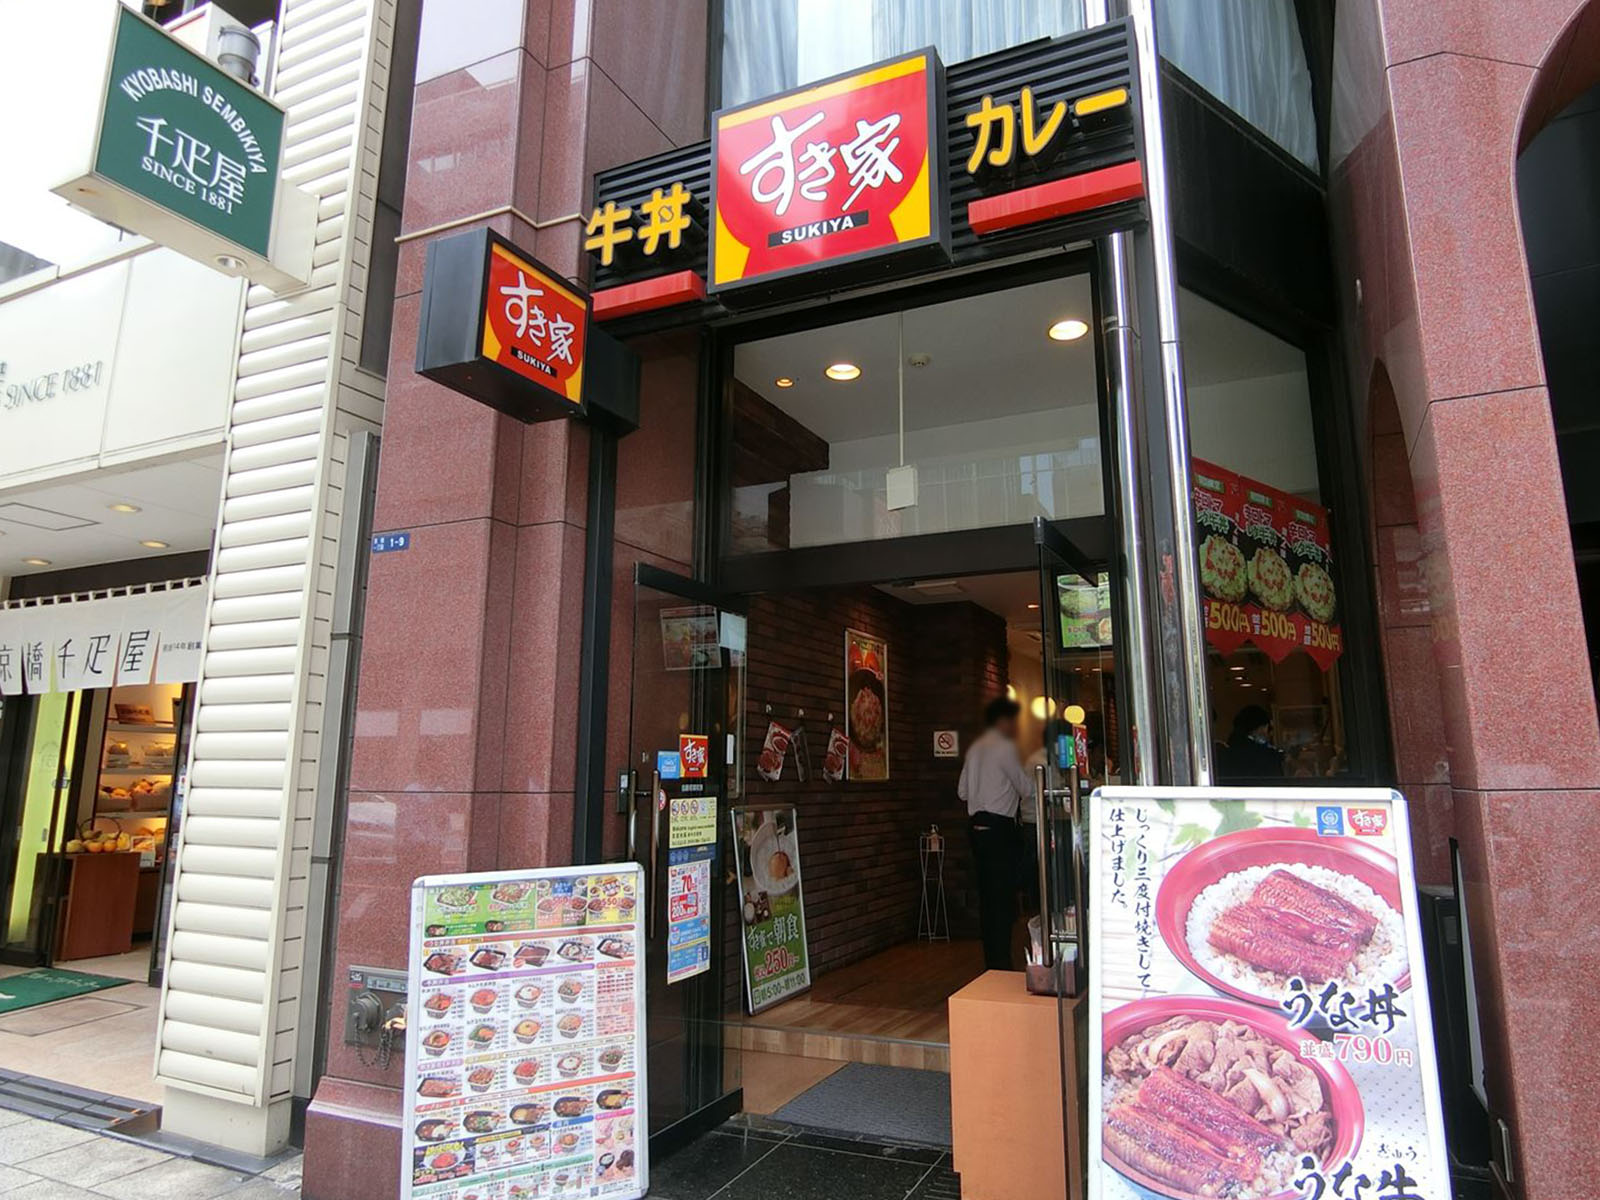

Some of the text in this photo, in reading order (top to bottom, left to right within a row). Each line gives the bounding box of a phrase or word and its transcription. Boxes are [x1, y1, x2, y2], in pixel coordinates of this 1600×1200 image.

[120, 67, 267, 175] KYOBASHI SEMBIKIYA
[136, 113, 247, 205] 千疋屋
[740, 111, 904, 217] すき家
[965, 86, 1128, 174] カレー
[141, 156, 234, 215] SINCE 1881
[585, 181, 692, 267] 牛丼
[781, 214, 855, 245] SUKIYA
[499, 270, 574, 365] すき家
[4, 371, 60, 411] SINCE
[61, 360, 103, 395] 1881
[516, 349, 553, 376] SUKIYA
[1283, 978, 1408, 1035] うな丼
